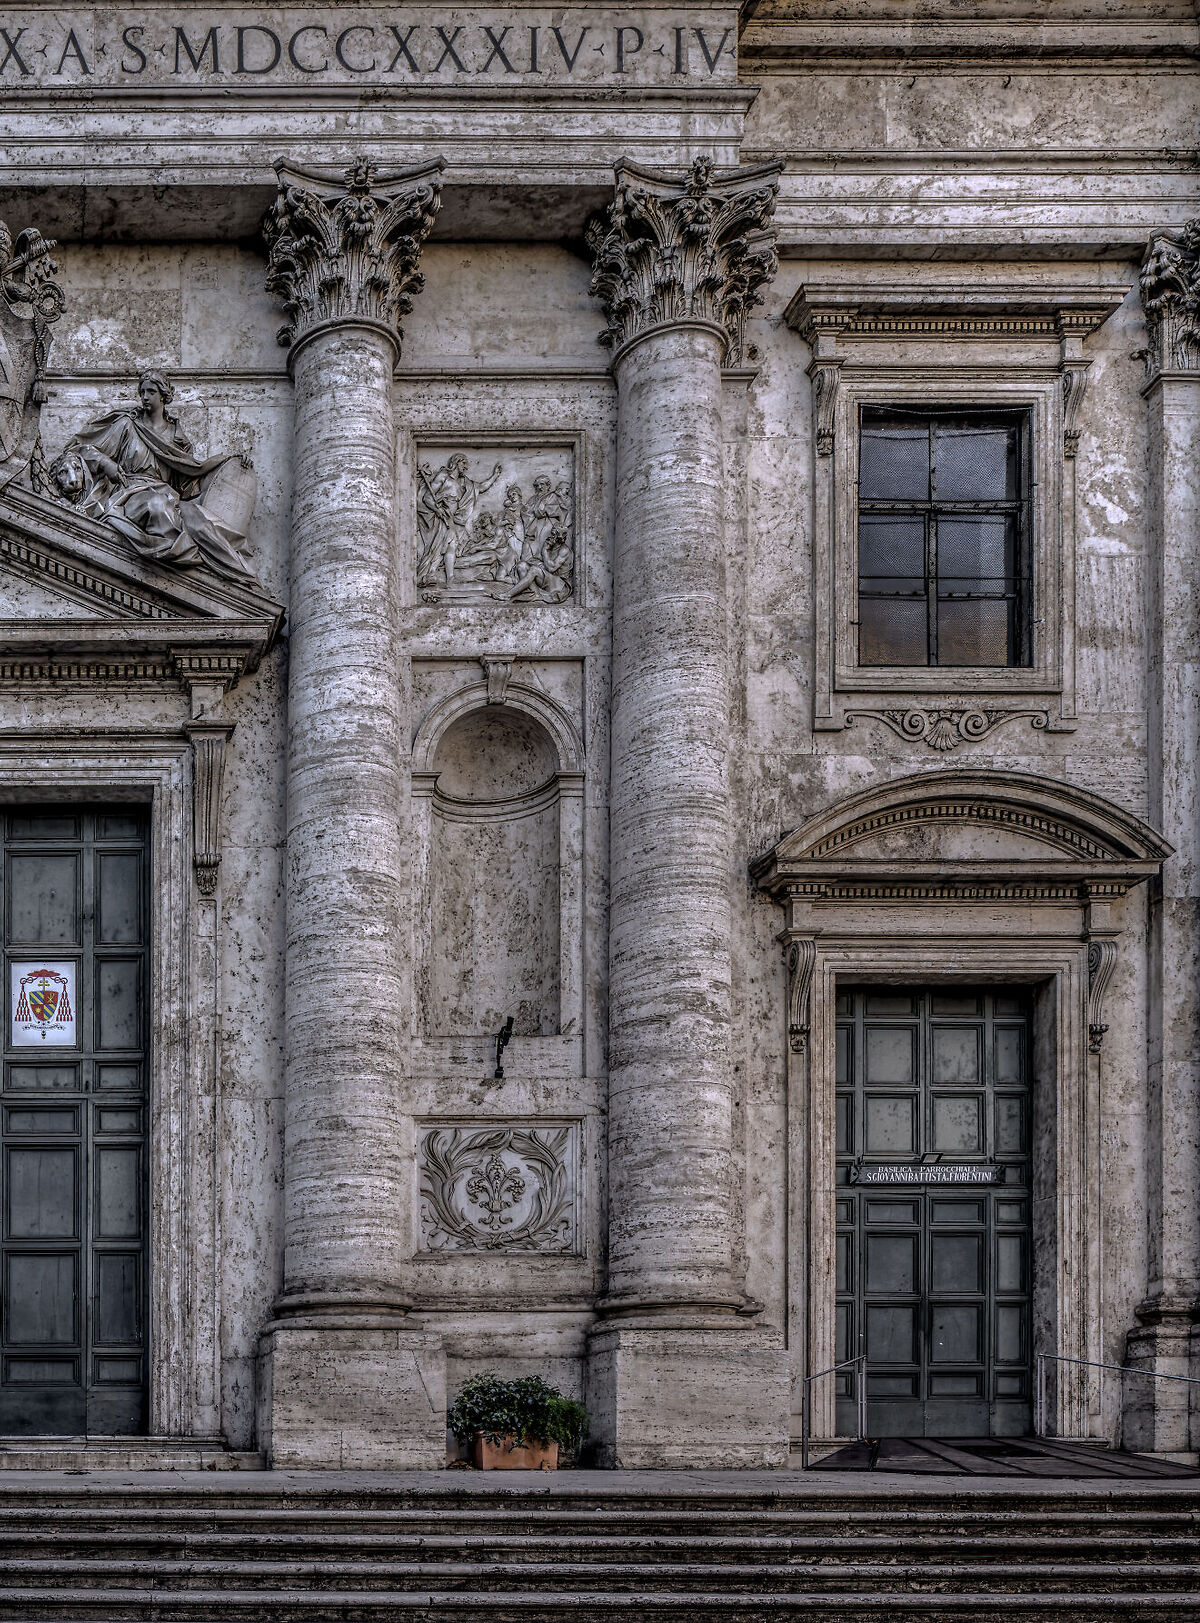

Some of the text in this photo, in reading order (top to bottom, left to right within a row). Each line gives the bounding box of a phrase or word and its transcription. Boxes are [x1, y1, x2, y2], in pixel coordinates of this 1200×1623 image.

[59, 28, 98, 74] A
[120, 26, 148, 74] S
[171, 24, 595, 74] MDCCXXXIV
[612, 26, 644, 73] P
[671, 26, 734, 75] IV
